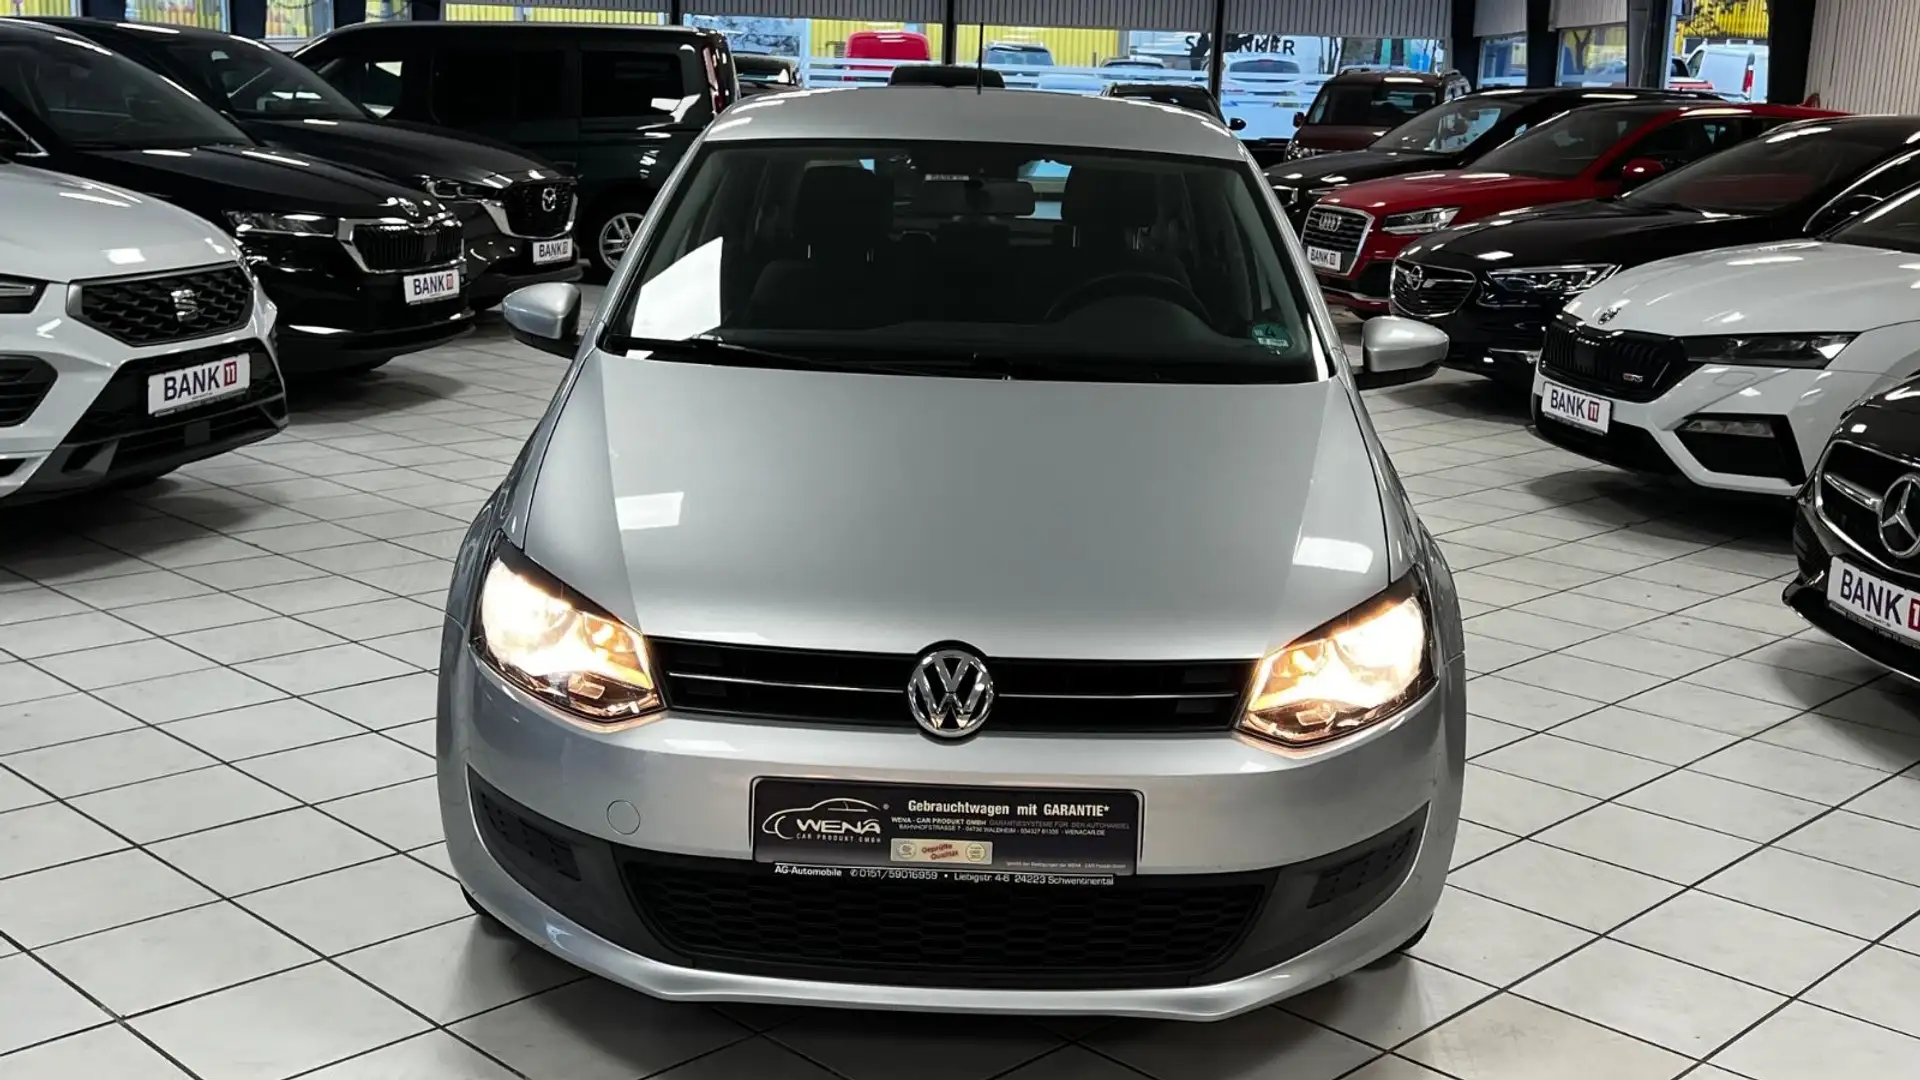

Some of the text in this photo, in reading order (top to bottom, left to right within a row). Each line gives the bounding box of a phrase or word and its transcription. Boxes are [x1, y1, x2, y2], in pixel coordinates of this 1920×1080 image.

[538, 242, 563, 258] BANK
[1310, 248, 1329, 264] BANK
[412, 275, 445, 296] BANK
[163, 362, 236, 402] BANK 11
[1550, 388, 1585, 419] BANK
[1840, 568, 1904, 626] BANK
[908, 799, 1010, 817] Gebrauchtwagen
[1017, 803, 1038, 816] mit
[796, 818, 881, 834] WENA
[891, 816, 912, 824] WENA
[796, 832, 881, 843] CAR PRODUKT GMBH
[774, 865, 842, 877] AG-Automobile
[1014, 874, 1046, 885] 24223
[1047, 875, 1114, 886] Schwentinental
